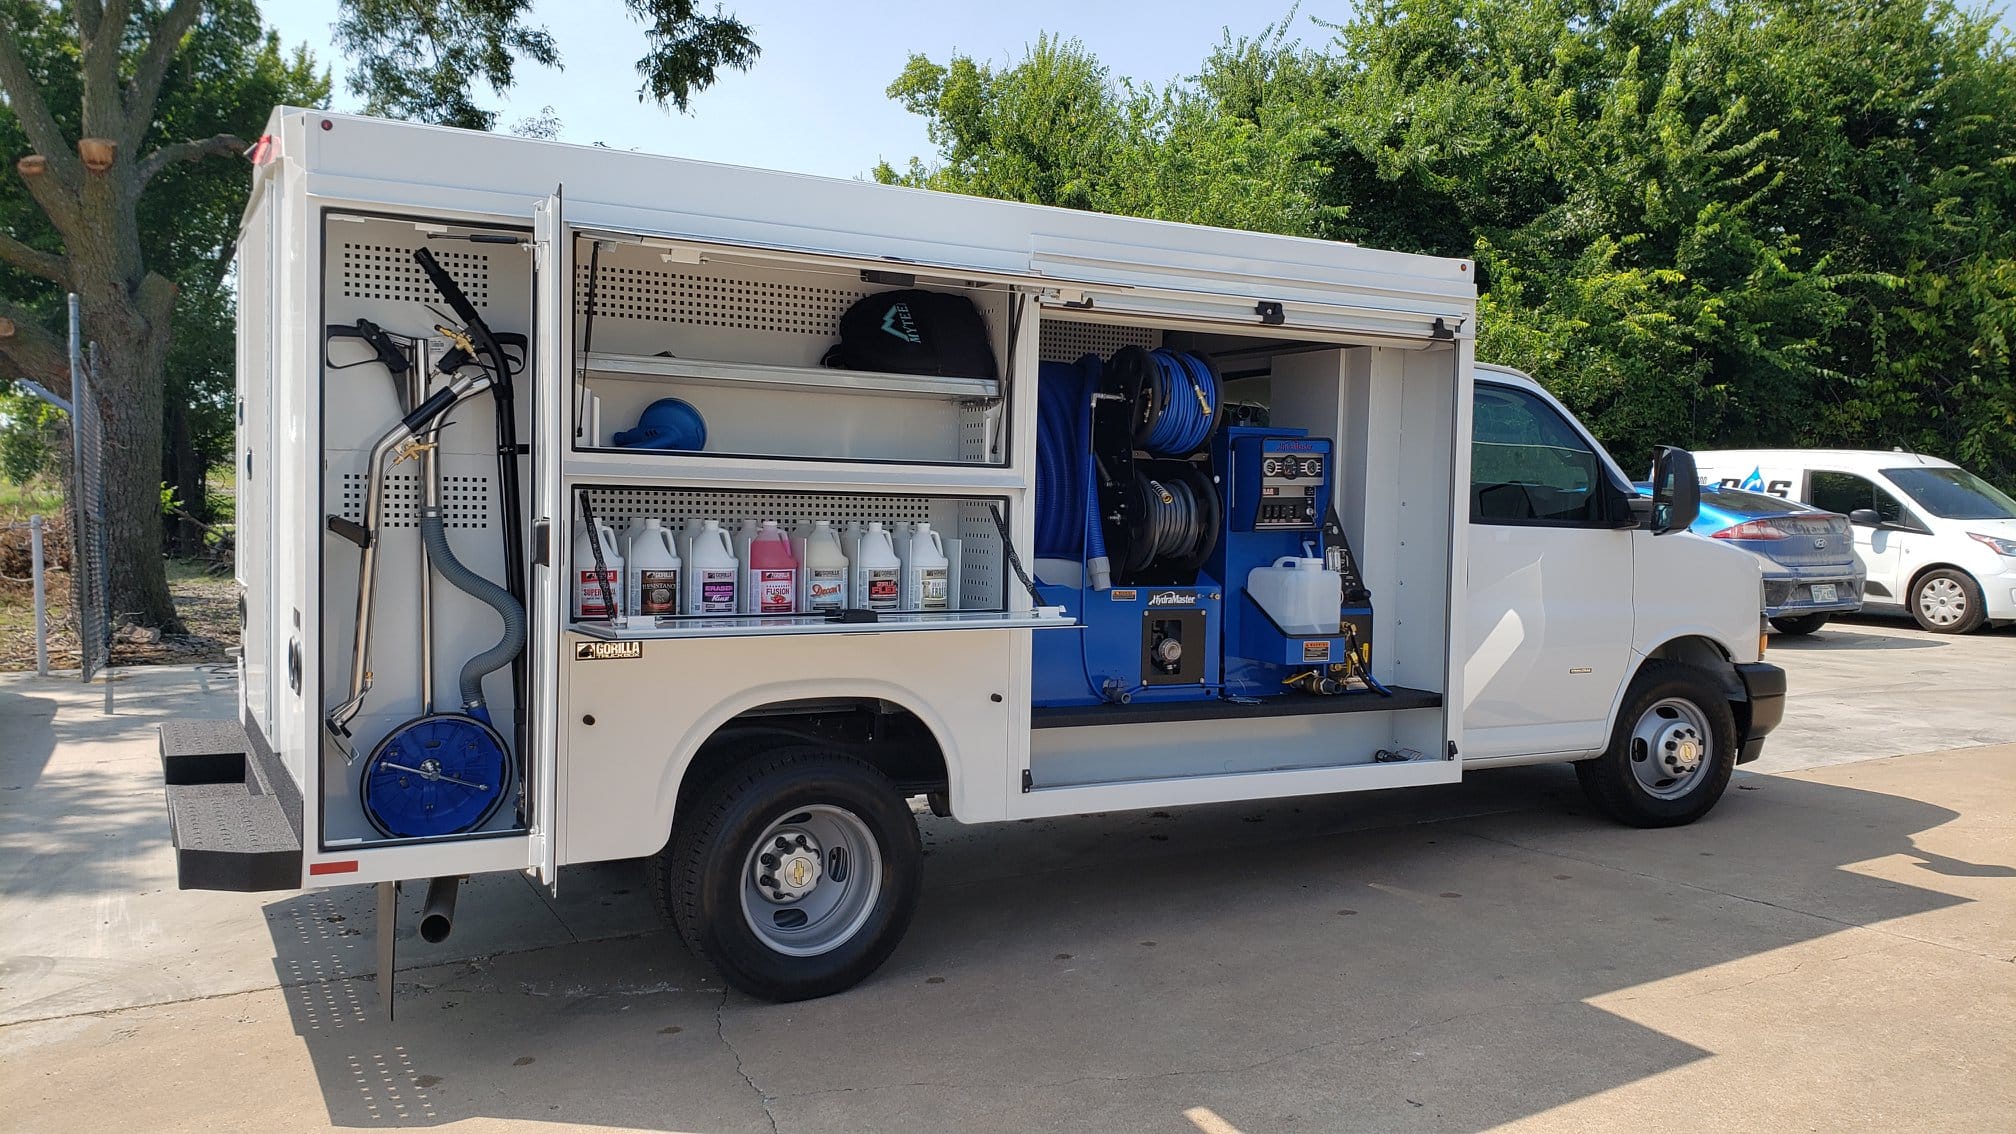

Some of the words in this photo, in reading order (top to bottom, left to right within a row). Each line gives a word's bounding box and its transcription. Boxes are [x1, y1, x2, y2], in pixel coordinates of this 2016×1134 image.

[896, 302, 922, 344] MYTEE
[766, 588, 790, 596] FUSION
[1148, 591, 1196, 606] HydraMaster
[596, 642, 640, 655] GORILLA
